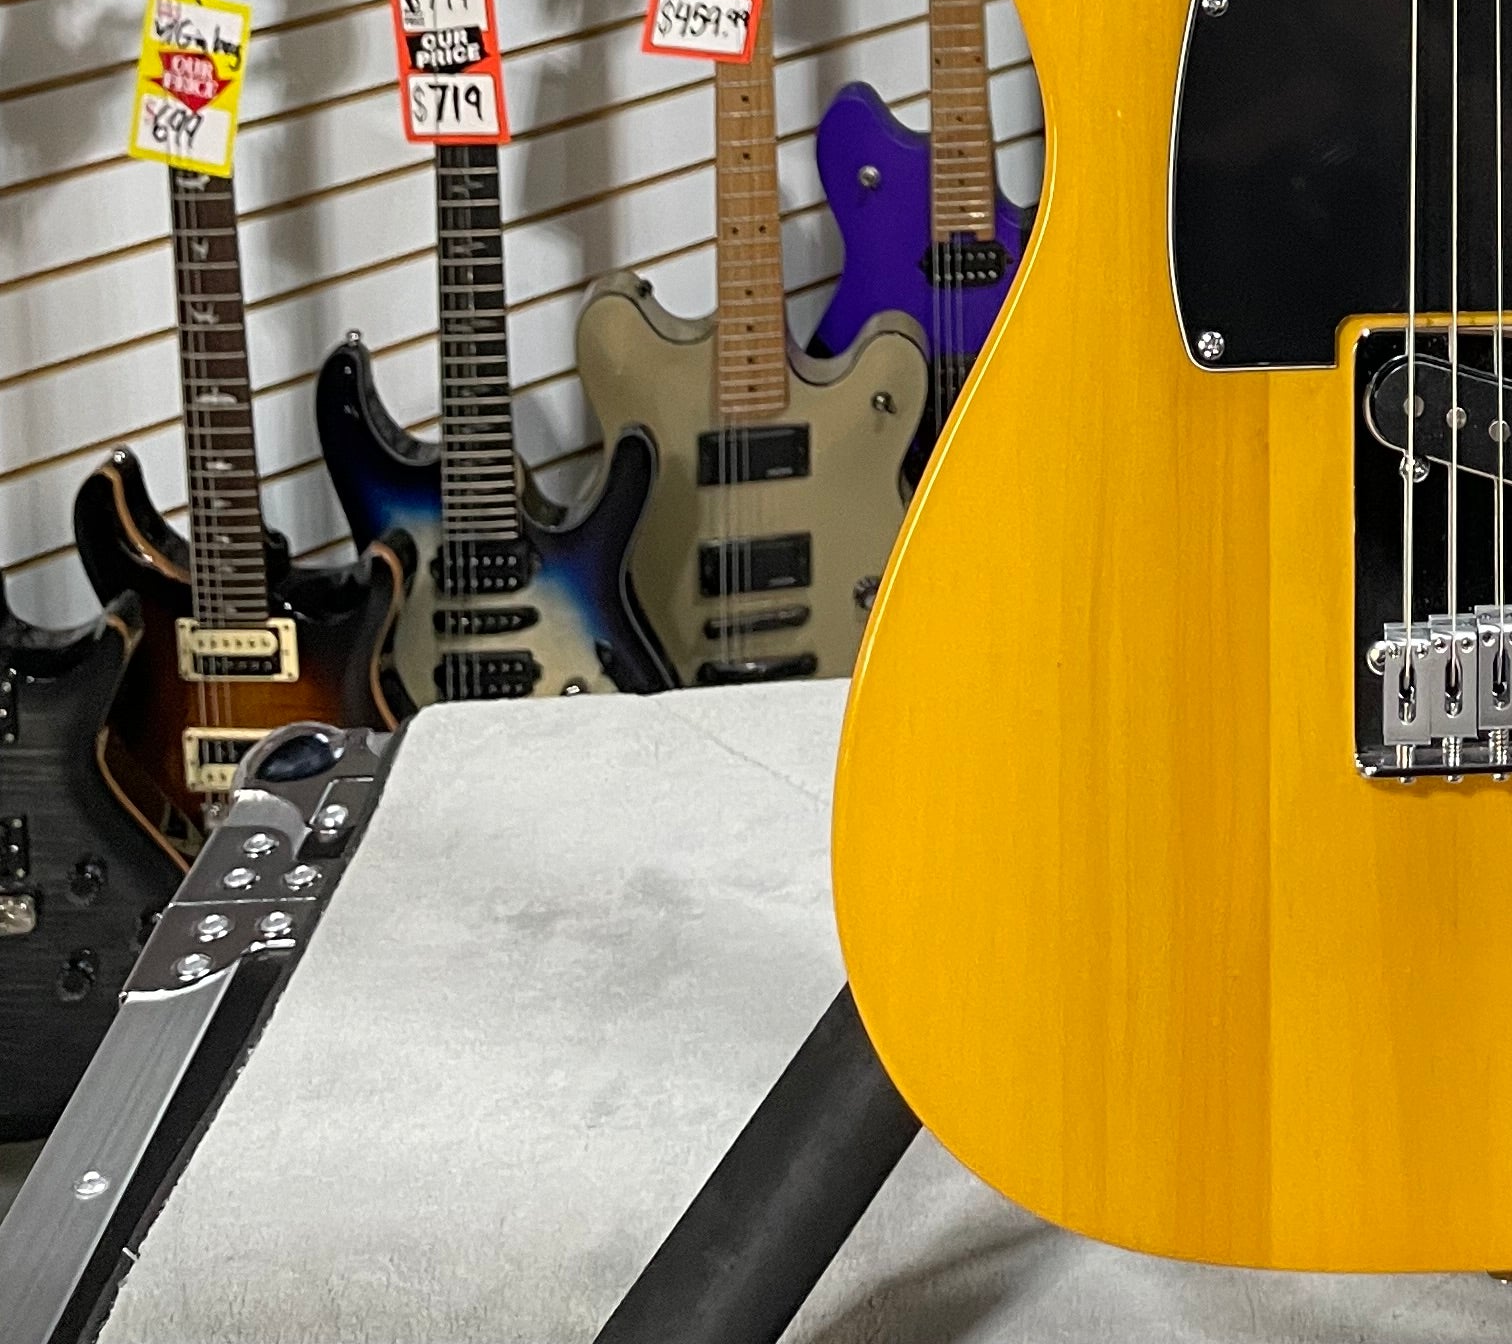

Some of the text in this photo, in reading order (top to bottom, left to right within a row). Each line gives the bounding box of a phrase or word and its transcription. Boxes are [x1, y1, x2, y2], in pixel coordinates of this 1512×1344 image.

[420, 27, 468, 51] OUR
[415, 42, 481, 72] PRICE
[412, 83, 484, 123] $719
